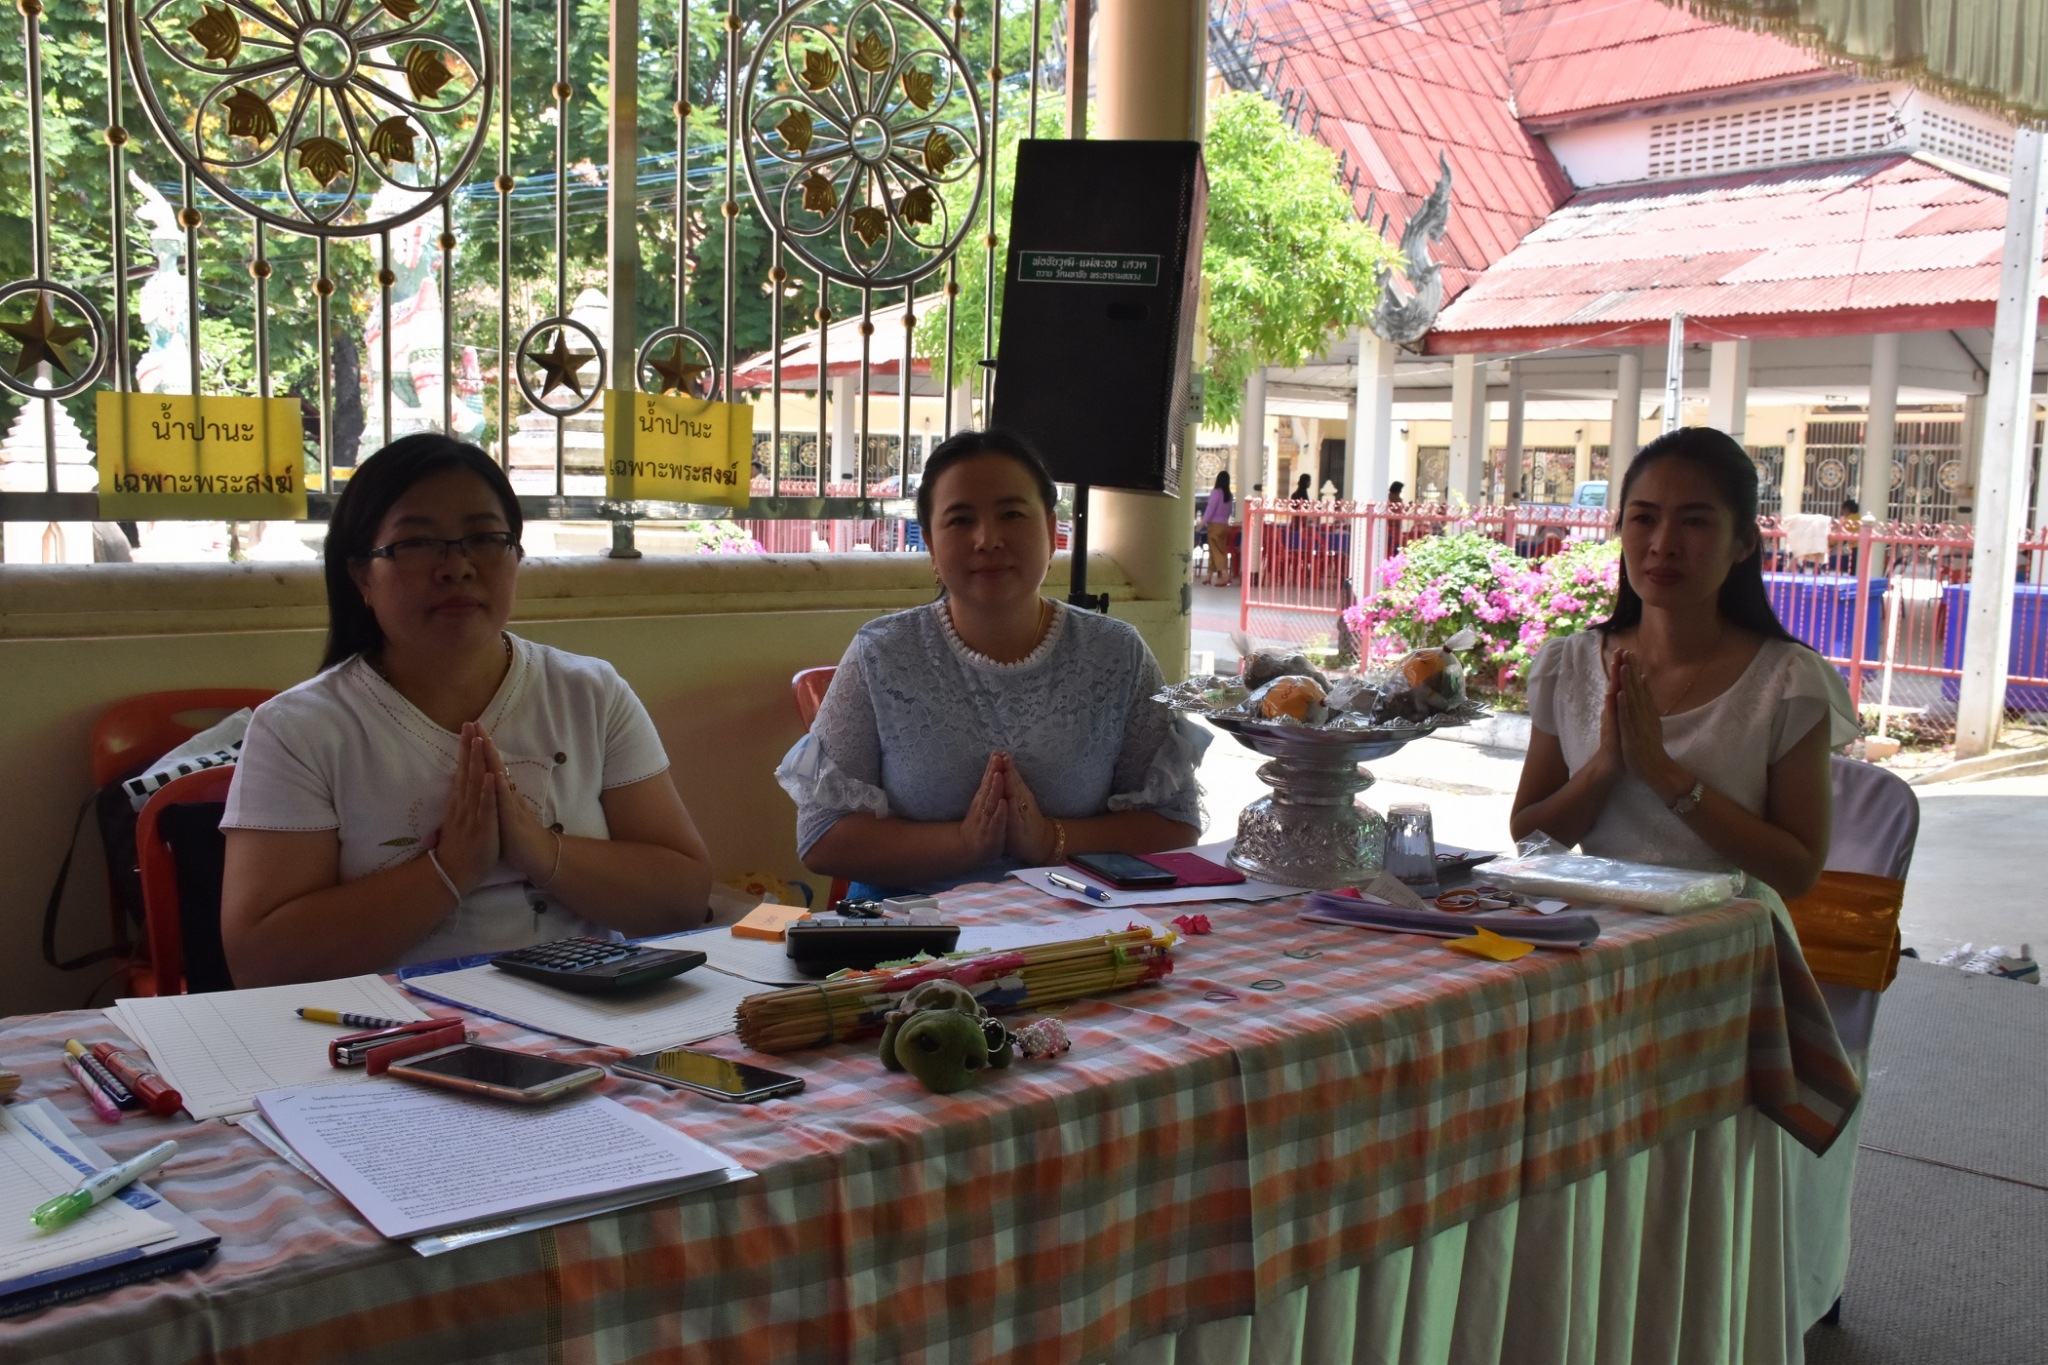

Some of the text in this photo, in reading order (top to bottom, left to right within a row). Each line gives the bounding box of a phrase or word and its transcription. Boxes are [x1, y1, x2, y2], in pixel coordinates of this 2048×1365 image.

[151, 402, 254, 442] น้ำปานะ
[638, 400, 712, 439] น้ำปานะ
[114, 464, 293, 494] เฉพาะพระสงฆ์
[609, 459, 739, 486] เฉพาะพระสงฆ์
